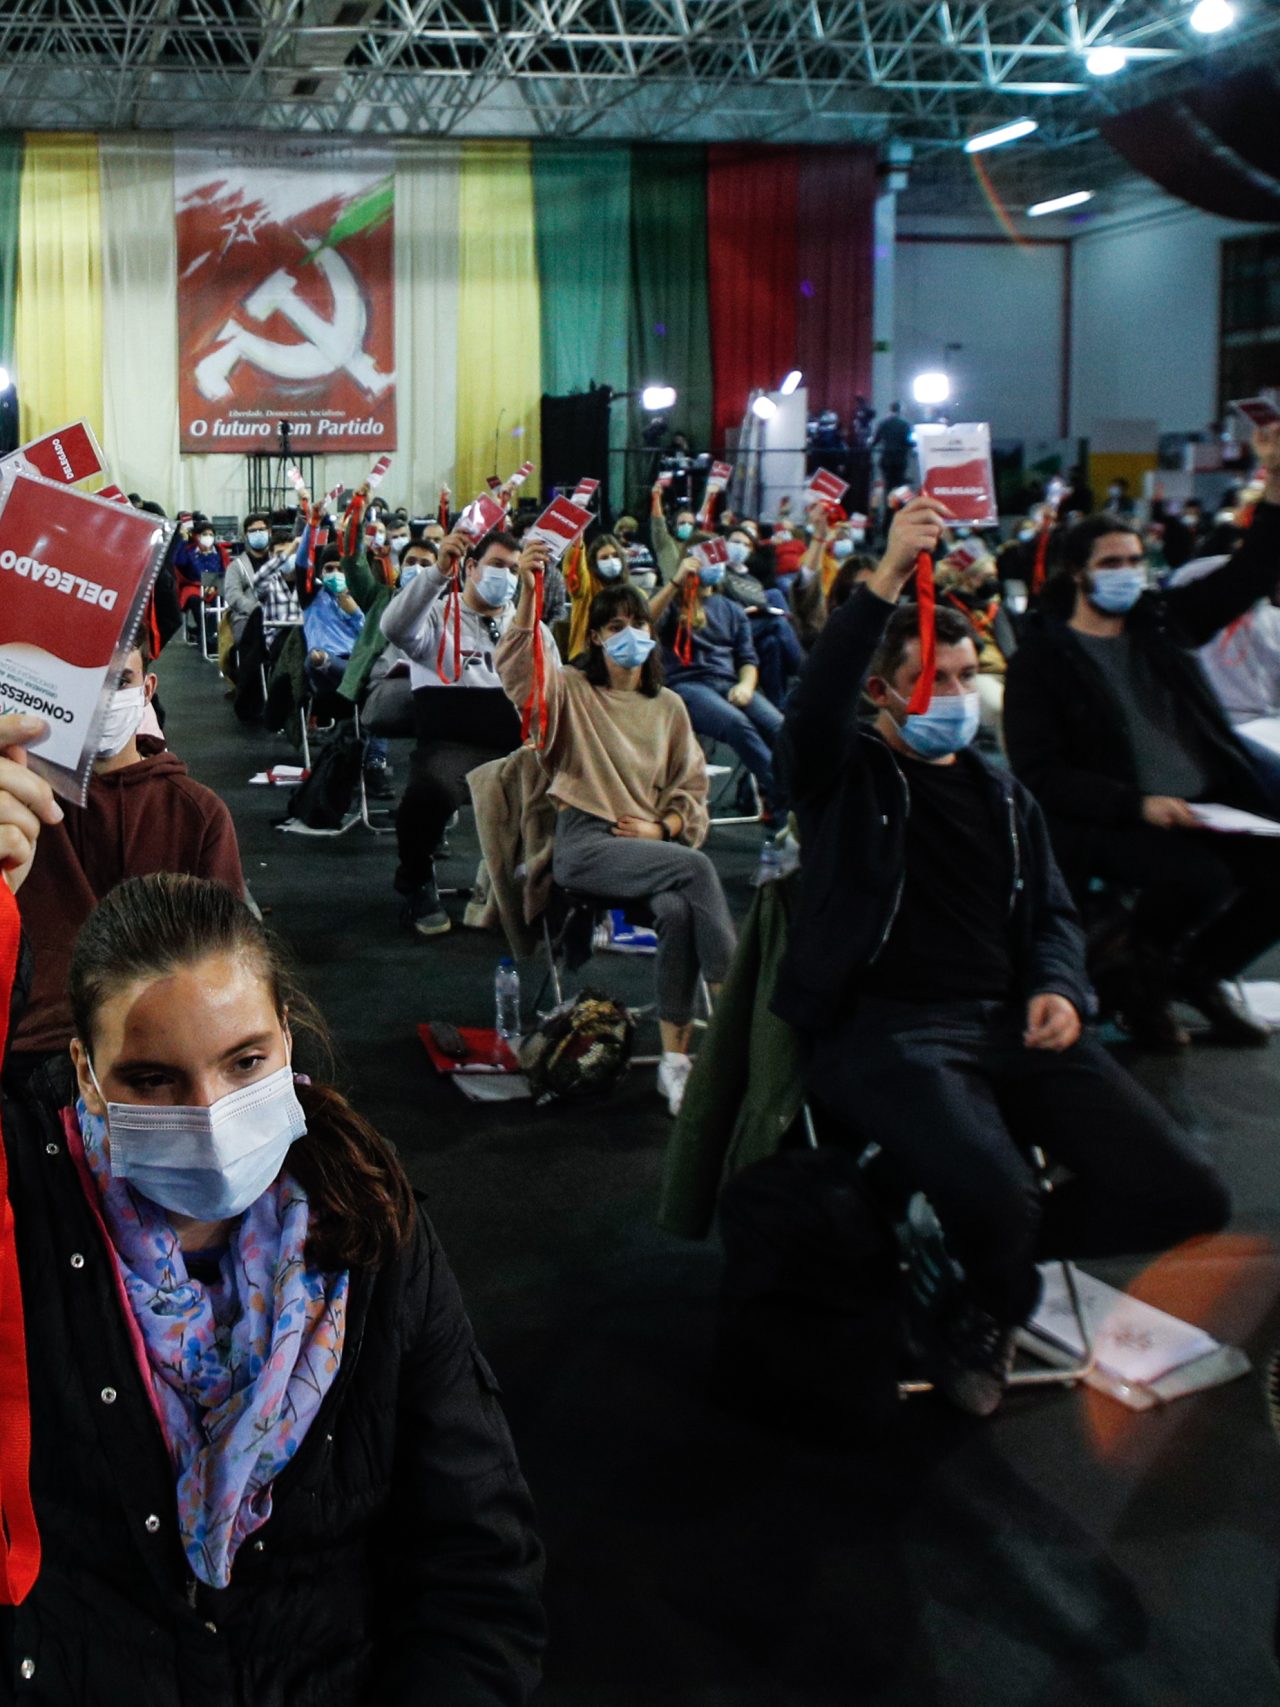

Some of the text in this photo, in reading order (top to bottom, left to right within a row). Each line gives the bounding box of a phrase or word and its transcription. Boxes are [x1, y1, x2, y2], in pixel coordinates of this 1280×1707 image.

[190, 419, 208, 436] O
[212, 418, 271, 437] futuro
[318, 417, 385, 436] Partido
[52, 438, 74, 480] DELEGADO
[0, 549, 118, 611] DELEGADO
